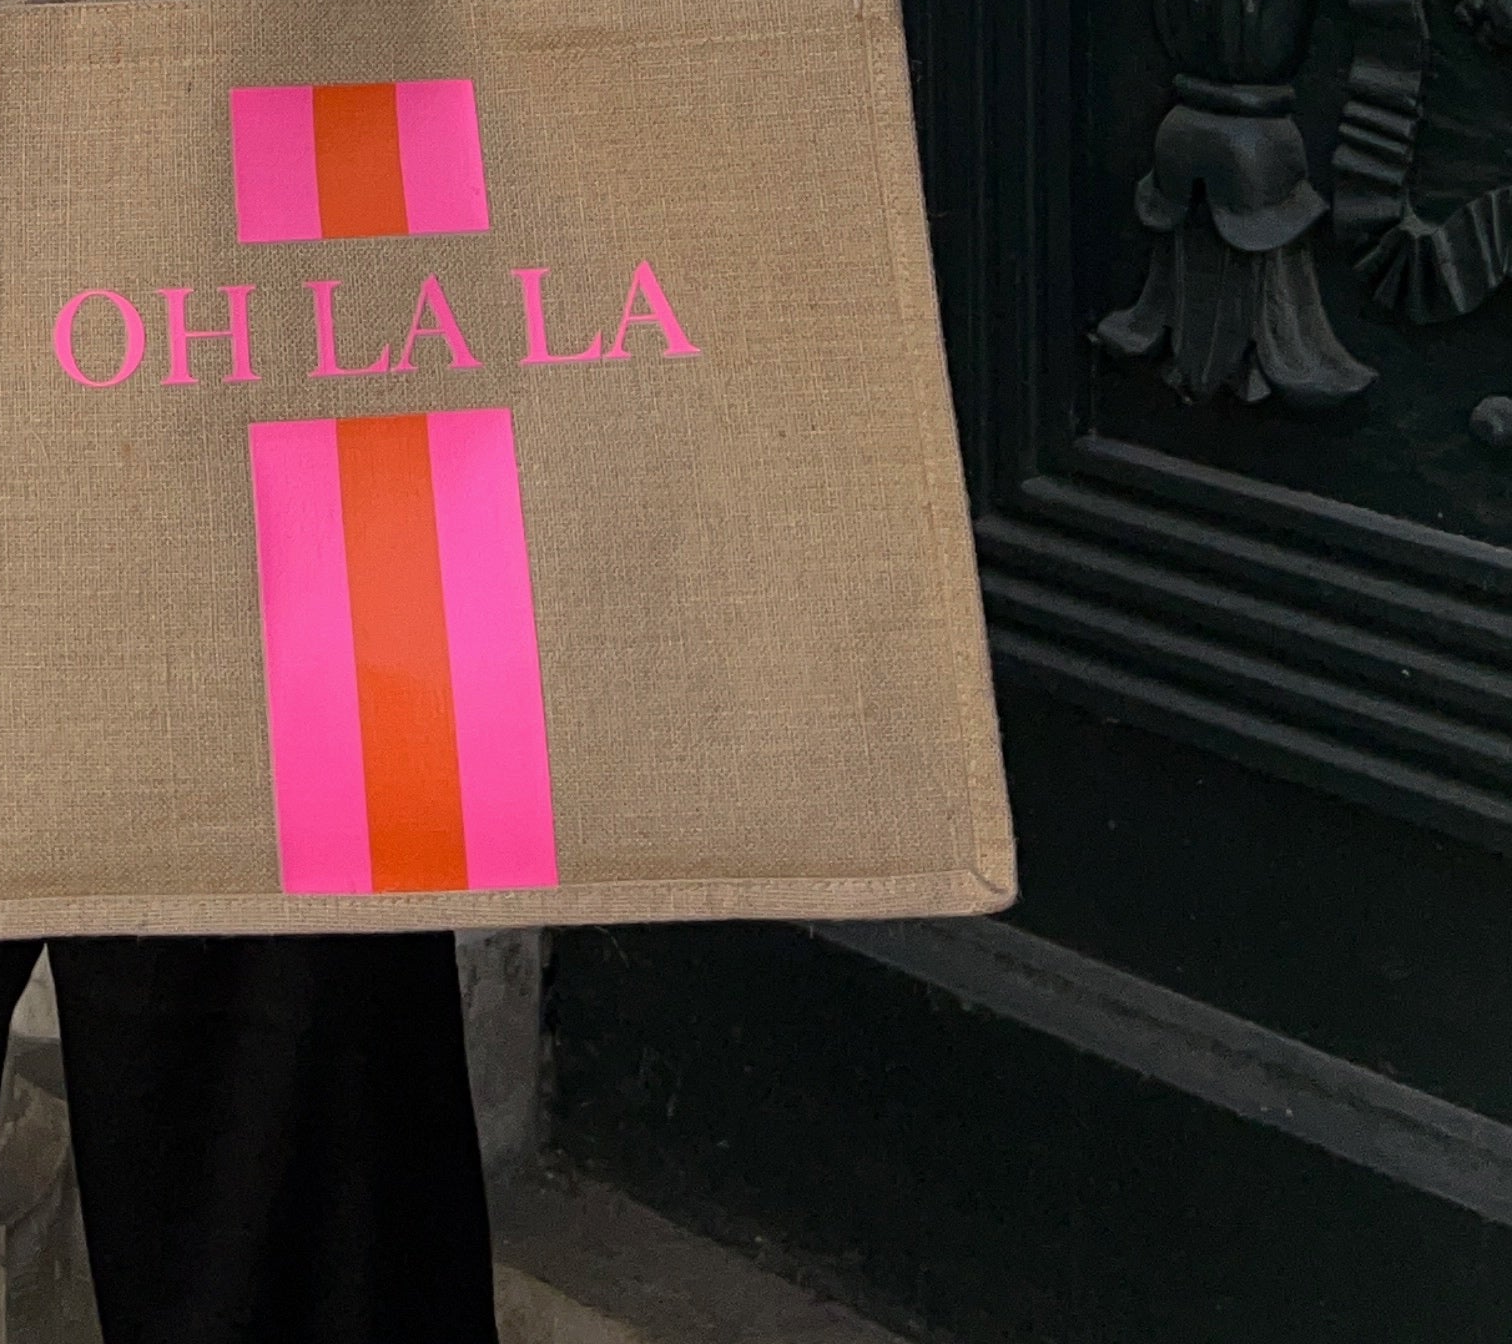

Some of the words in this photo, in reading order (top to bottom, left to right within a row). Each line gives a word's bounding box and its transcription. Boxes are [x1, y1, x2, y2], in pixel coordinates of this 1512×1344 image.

[53, 286, 262, 388] OH
[304, 273, 483, 378] LA
[511, 260, 701, 365] LA
